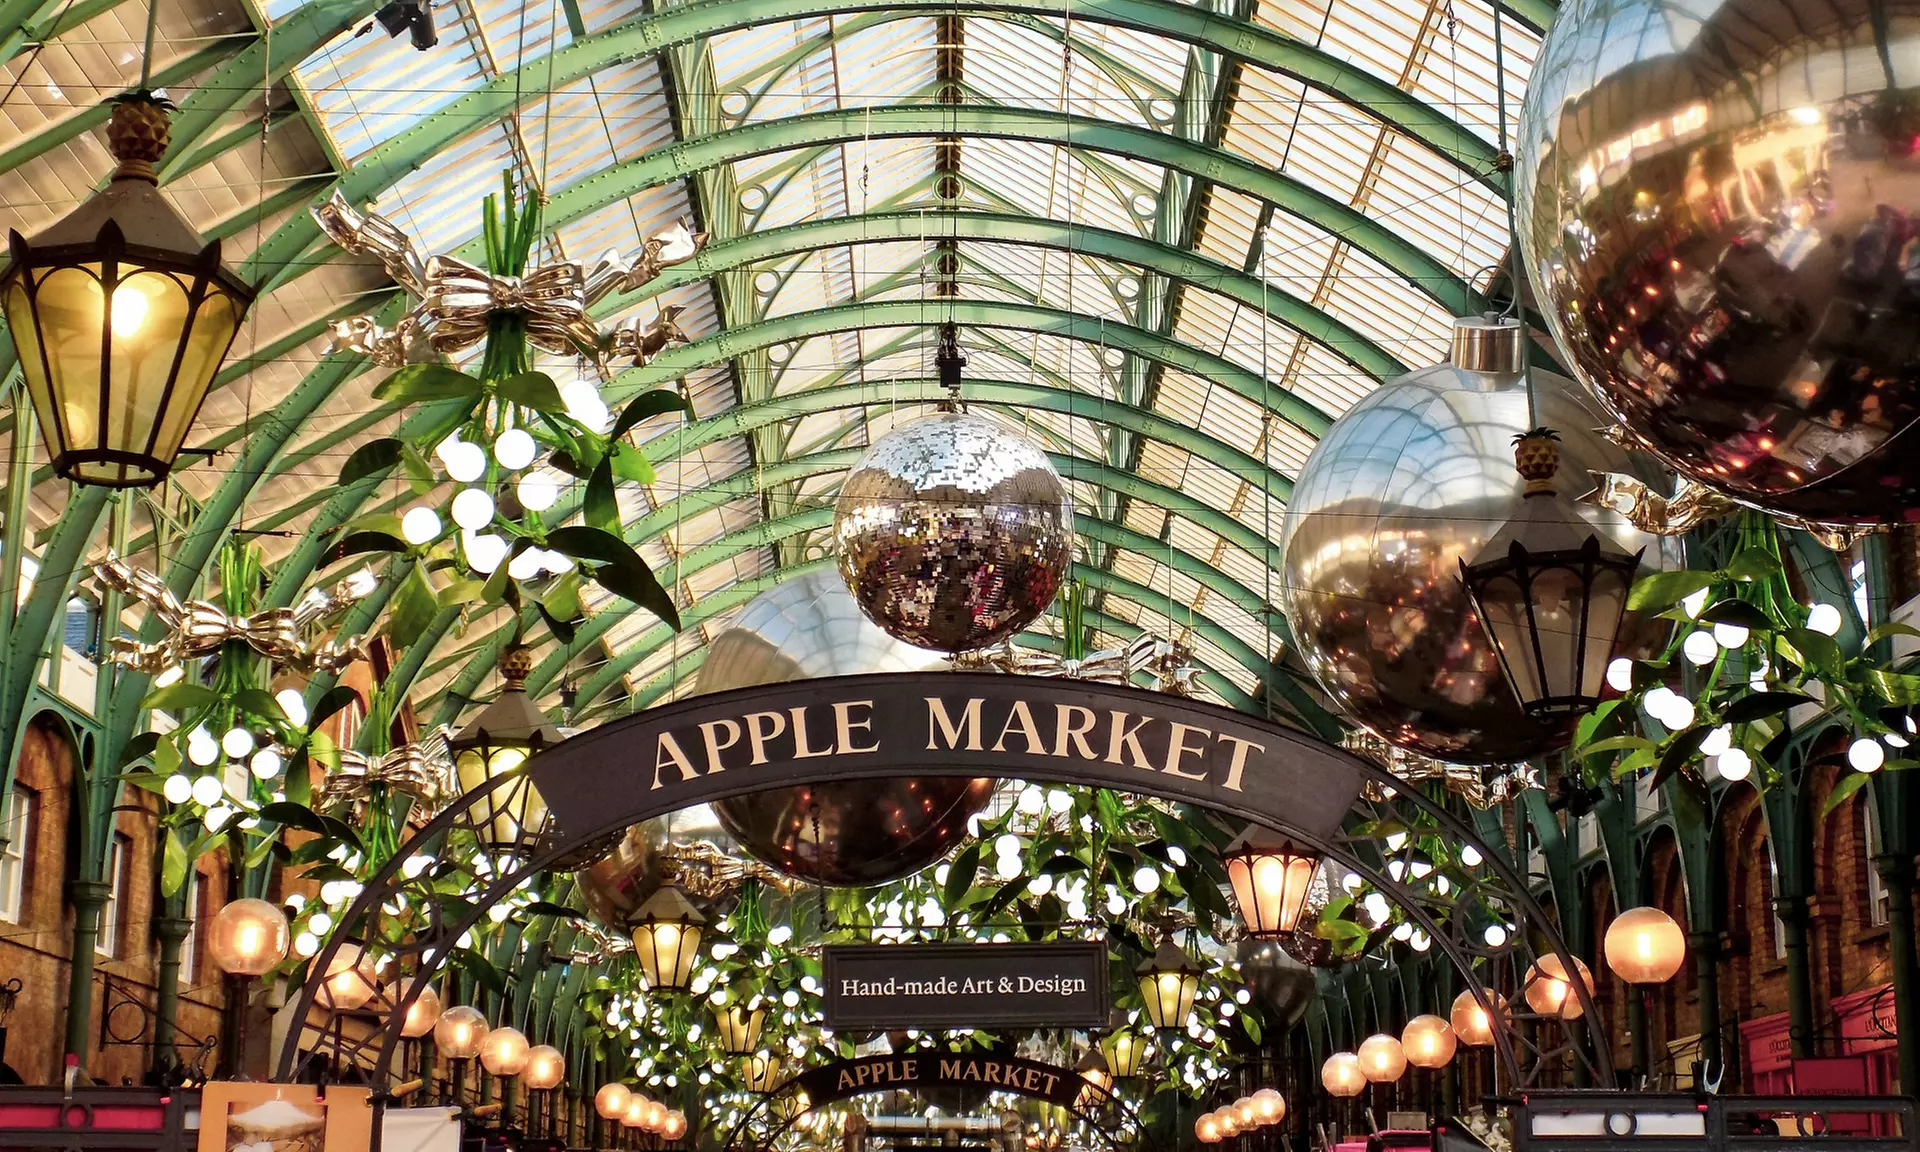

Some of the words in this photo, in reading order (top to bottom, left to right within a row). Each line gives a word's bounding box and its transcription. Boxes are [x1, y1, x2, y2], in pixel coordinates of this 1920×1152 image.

[650, 700, 880, 791] APPLE
[923, 697, 1267, 793] MARKET
[840, 977, 958, 997] Hand-made
[962, 976, 994, 994] Art
[997, 976, 1014, 994] &
[1018, 975, 1087, 997] Design
[837, 1059, 919, 1091] APPLE
[939, 1059, 1060, 1095] MARKET
